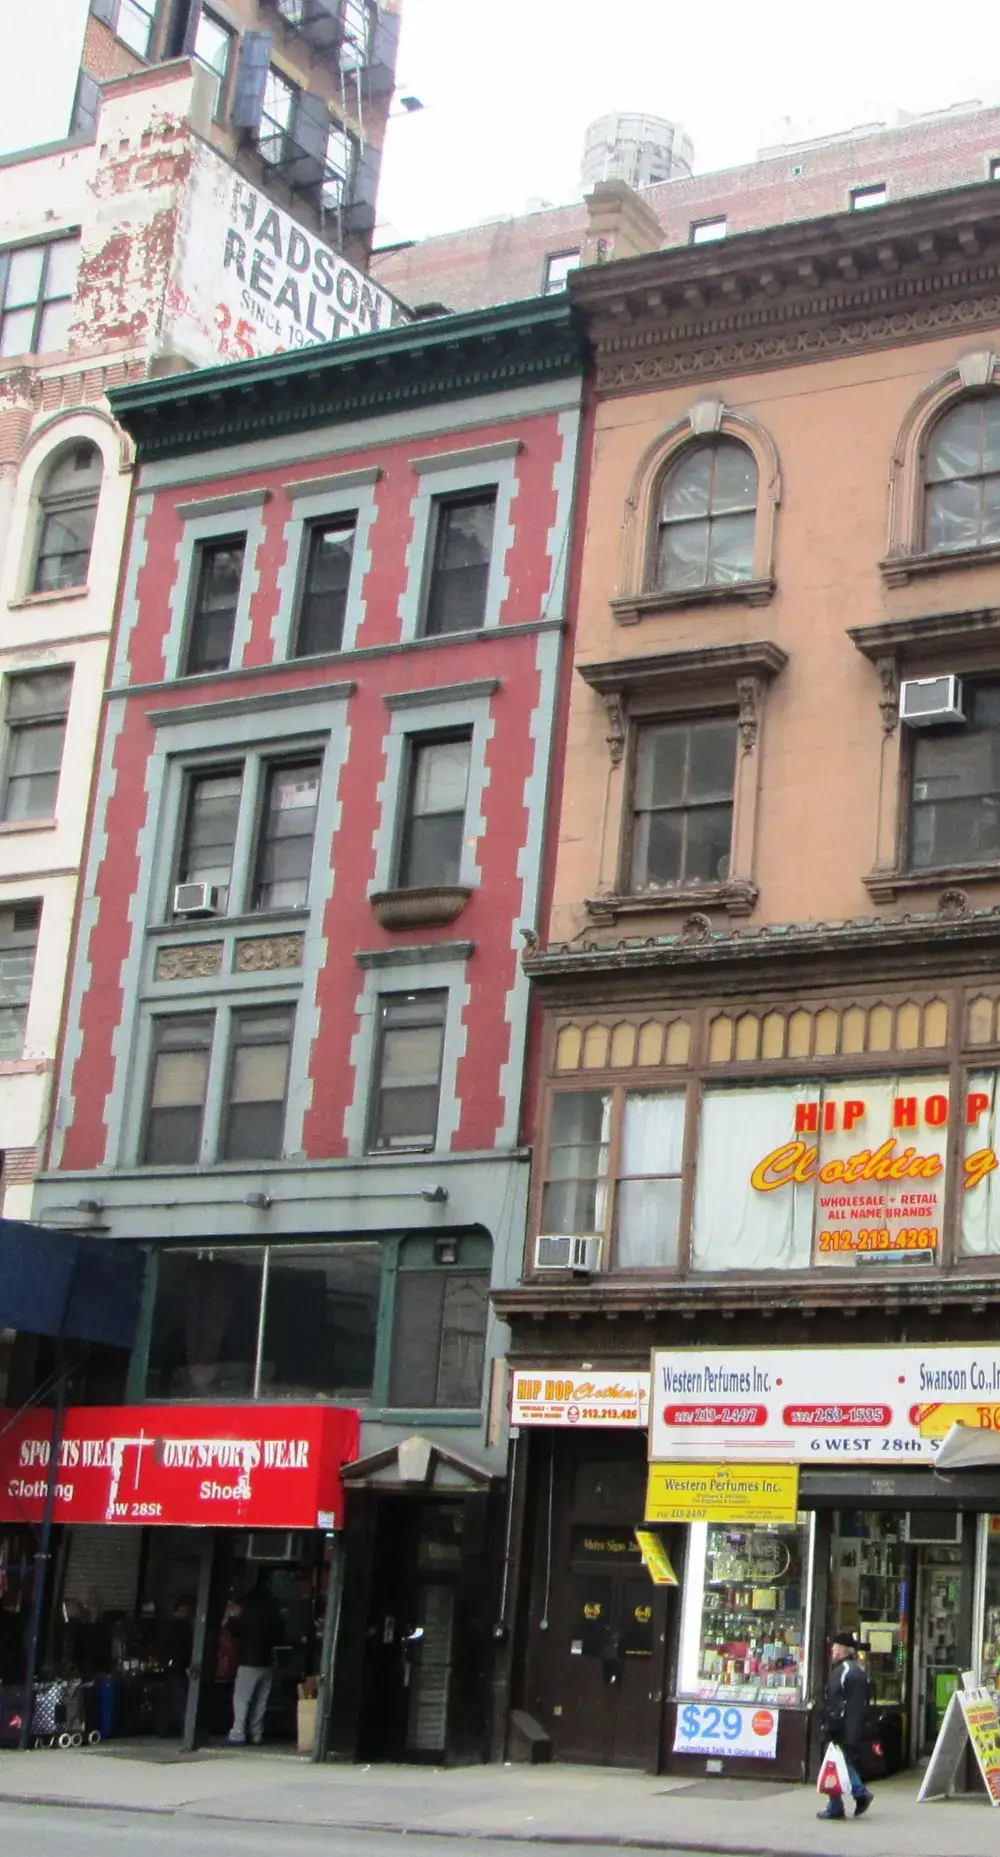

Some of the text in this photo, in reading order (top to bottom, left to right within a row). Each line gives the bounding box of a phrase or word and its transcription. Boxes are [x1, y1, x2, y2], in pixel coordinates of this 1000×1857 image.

[232, 180, 382, 334] HADSON
[240, 289, 282, 336] SINCE
[795, 1092, 990, 1133] HIP HOP
[750, 1138, 999, 1191] Clothing
[820, 1195, 885, 1207] WHOLESALE
[901, 1194, 938, 1204] RETAIL
[827, 1207, 932, 1219] ALL NAME BRANDS
[517, 1380, 541, 1399] HIP
[545, 1380, 573, 1400] HOP
[662, 1365, 772, 1393] Western Perfumes Inc.
[919, 1362, 967, 1391] Swanson
[19, 1440, 79, 1467] SPOTS
[263, 1440, 309, 1468] WEAR
[810, 1439, 820, 1451] 6
[825, 1438, 872, 1451] WEST
[881, 1439, 921, 1451] 28th
[7, 1480, 74, 1501] Clothng
[665, 1479, 781, 1492] Western Perfumes Inc.
[131, 1503, 162, 1516] 28St
[681, 1703, 742, 1741] $29
